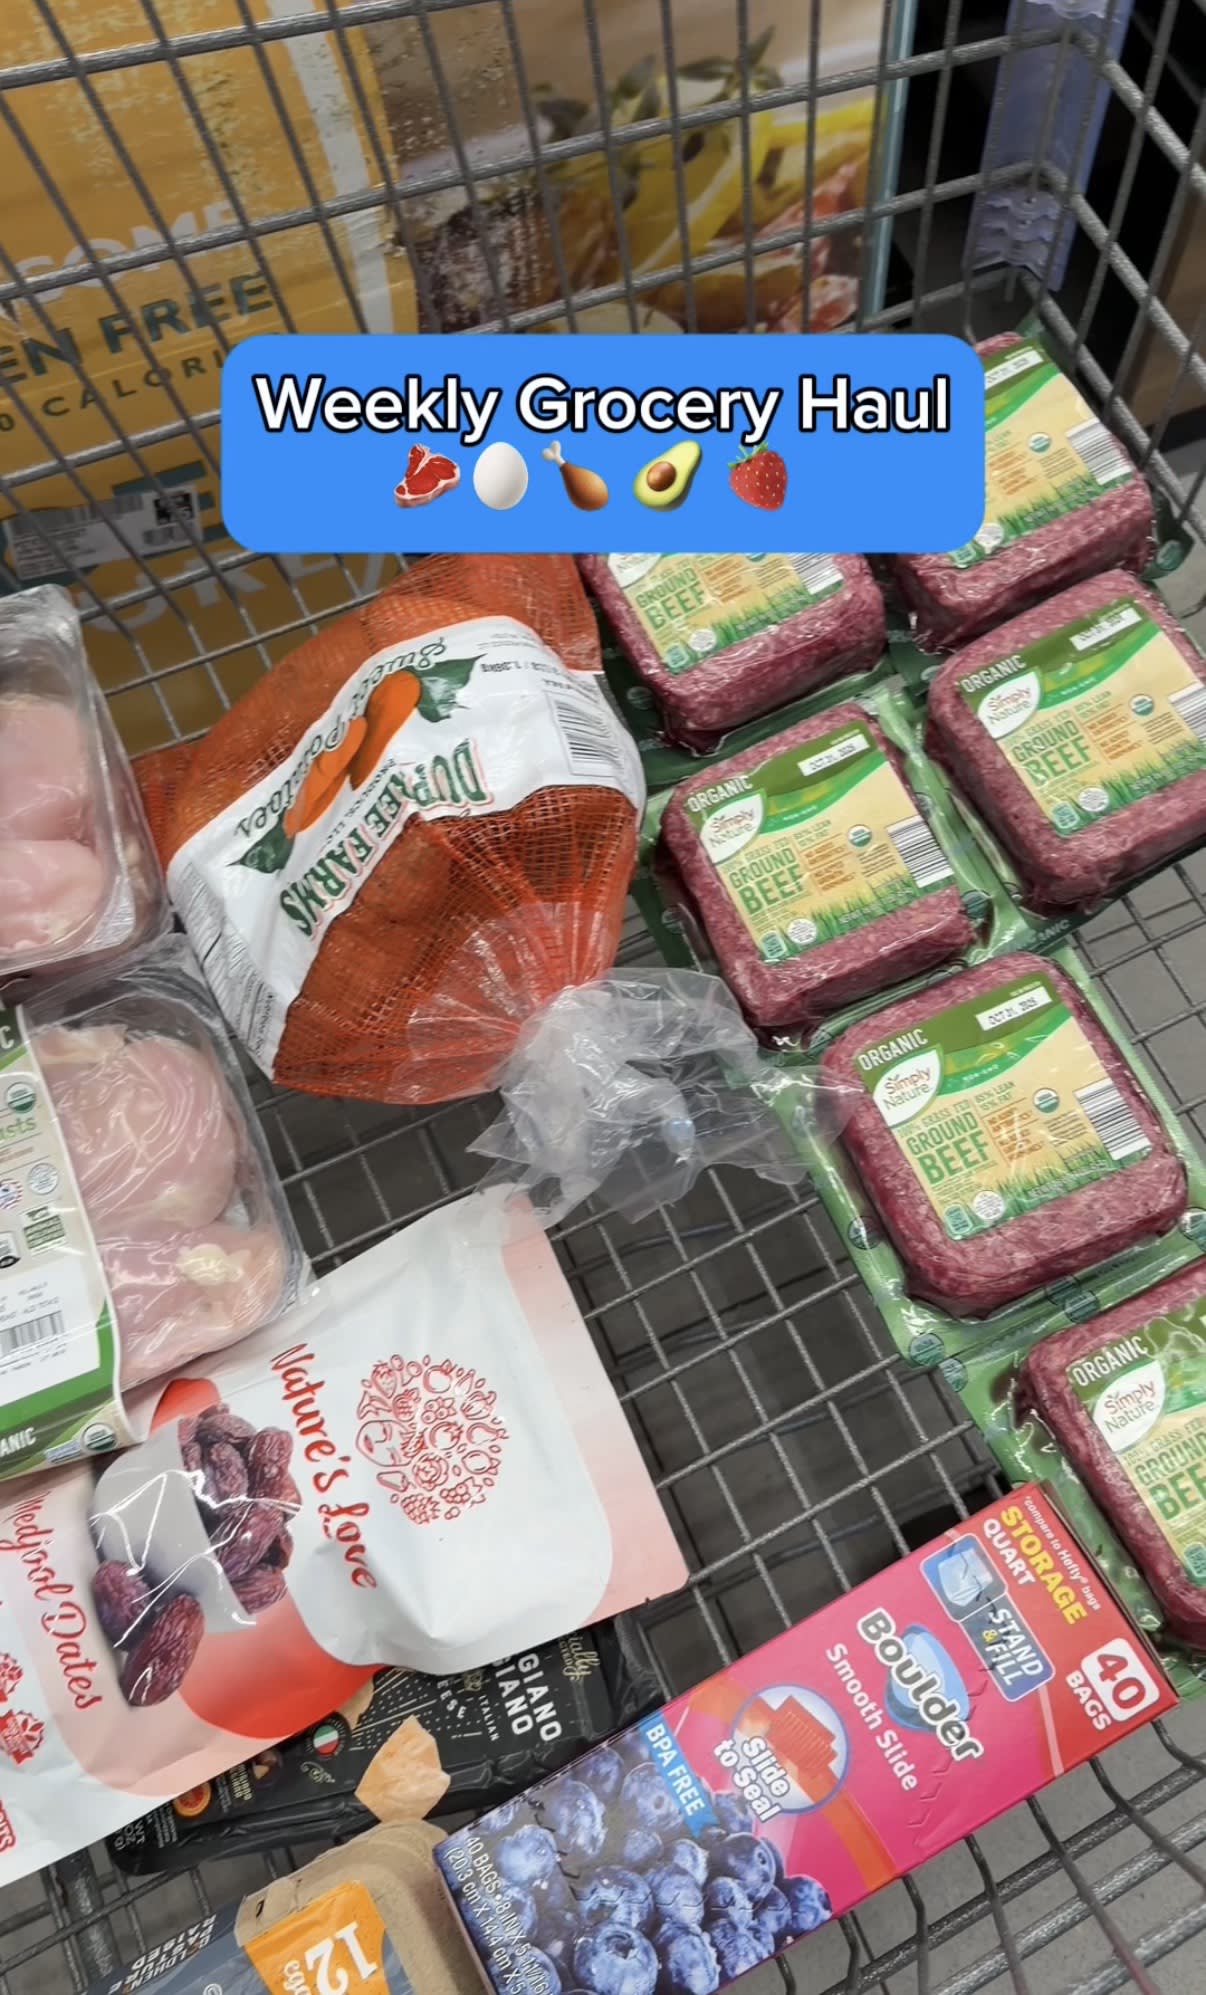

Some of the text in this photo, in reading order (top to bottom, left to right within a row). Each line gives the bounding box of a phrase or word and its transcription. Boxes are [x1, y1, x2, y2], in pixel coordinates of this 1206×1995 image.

[98, 272, 273, 354] FREE
[634, 567, 698, 609] GROUND
[644, 584, 705, 631] BEEF
[961, 655, 1027, 693] ORGANIC
[988, 683, 1032, 710] Simply
[988, 700, 1031, 725] Nature
[1012, 719, 1080, 763] GROUND
[1023, 736, 1091, 788] BEEF
[687, 776, 753, 812] ORGANIC
[707, 822, 753, 848] Nature
[710, 806, 755, 833] Simply
[279, 834, 376, 938] FARMS
[729, 847, 797, 889] GROUND
[738, 863, 805, 915] BEEF
[858, 1028, 929, 1071] ORGANIC
[883, 1082, 931, 1110] Nature
[884, 1066, 932, 1096] Simply
[906, 1111, 978, 1156] GROUND
[917, 1130, 989, 1184] BEEF
[1072, 1336, 1149, 1387] ORGANIC
[1103, 1381, 1156, 1415] Simply
[1103, 1400, 1155, 1434] Nature
[270, 1343, 378, 1589] Nature's Love
[982, 1518, 1036, 1587] QUART
[1000, 1506, 1088, 1626] STORAGE
[1081, 1584, 1101, 1611] bags
[41, 1601, 103, 1710] Dates
[982, 1630, 998, 1644] &
[990, 1608, 1044, 1677] STAND
[857, 1607, 985, 1762] Boulder
[985, 1644, 1025, 1687] FILL
[1097, 1653, 1147, 1711] 40
[479, 1695, 500, 1741] ITALIAN
[518, 1653, 562, 1741] GIANO
[825, 1642, 918, 1792] Smooth Slide
[1066, 1670, 1112, 1731] BAGS
[645, 1723, 706, 1817] BPA FREE
[713, 1739, 782, 1823] to Seal
[743, 1736, 792, 1798] Slide
[445, 1847, 472, 1882] (20.3
[465, 1835, 482, 1854] 40
[462, 1882, 483, 1905] cm
[474, 1853, 502, 1894] BAGS
[473, 1904, 490, 1918] X
[496, 1902, 506, 1914] 8
[501, 1910, 520, 1935] IN
[132, 1914, 216, 1970] RAISED
[479, 1918, 500, 1948] 14.4
[511, 1933, 527, 1946] X
[518, 1943, 531, 1957] 5
[108, 1924, 214, 1995] PASTURE
[304, 1921, 379, 1995] 12
[492, 1947, 512, 1970] cm
[504, 1968, 523, 1984] X
